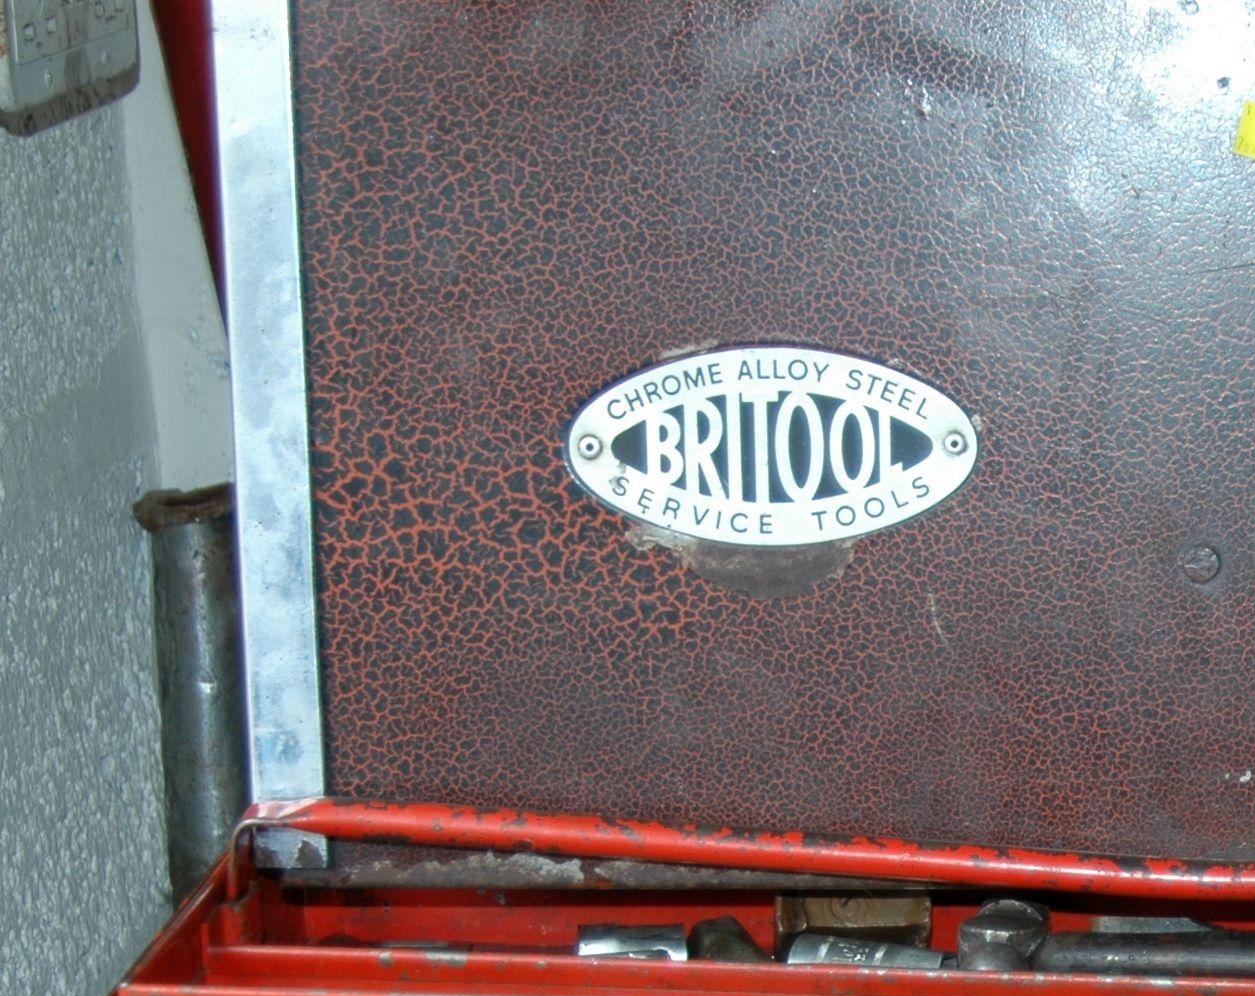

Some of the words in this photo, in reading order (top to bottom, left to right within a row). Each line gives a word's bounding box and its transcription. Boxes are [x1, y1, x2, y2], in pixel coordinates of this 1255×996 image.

[606, 362, 724, 421] CHROME
[736, 358, 831, 383] ALLOY
[844, 368, 930, 421] STEEL
[644, 390, 906, 503] BRITOOL
[610, 476, 775, 535] SERVICE
[811, 476, 932, 533] TOOLS
